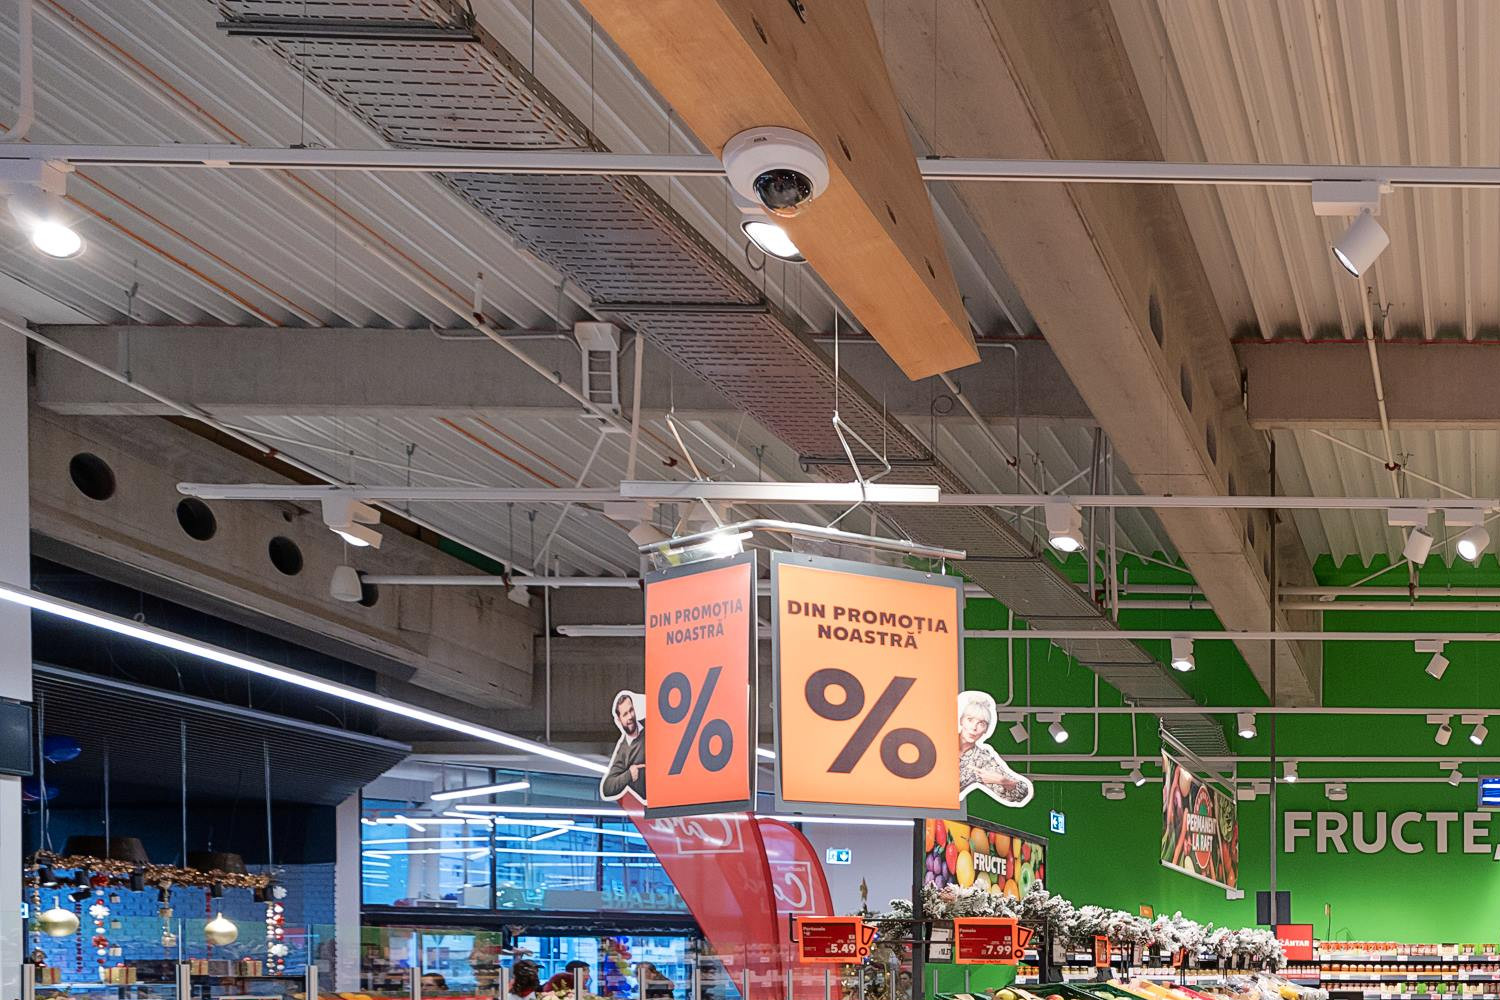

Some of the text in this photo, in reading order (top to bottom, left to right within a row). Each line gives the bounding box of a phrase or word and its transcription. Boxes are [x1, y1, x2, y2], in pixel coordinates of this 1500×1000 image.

[650, 597, 743, 629] DIN PROMOȚIA
[787, 600, 948, 634] DIN PROMOȚIA
[666, 620, 725, 645] NOASTRĂ
[817, 624, 918, 649] NOASTRĂ
[805, 668, 937, 780] %
[1187, 813, 1217, 835] PERMANENT
[973, 852, 1007, 876] FRUCTE
[831, 944, 856, 953] 5.49
[986, 945, 1011, 955] 7.99
